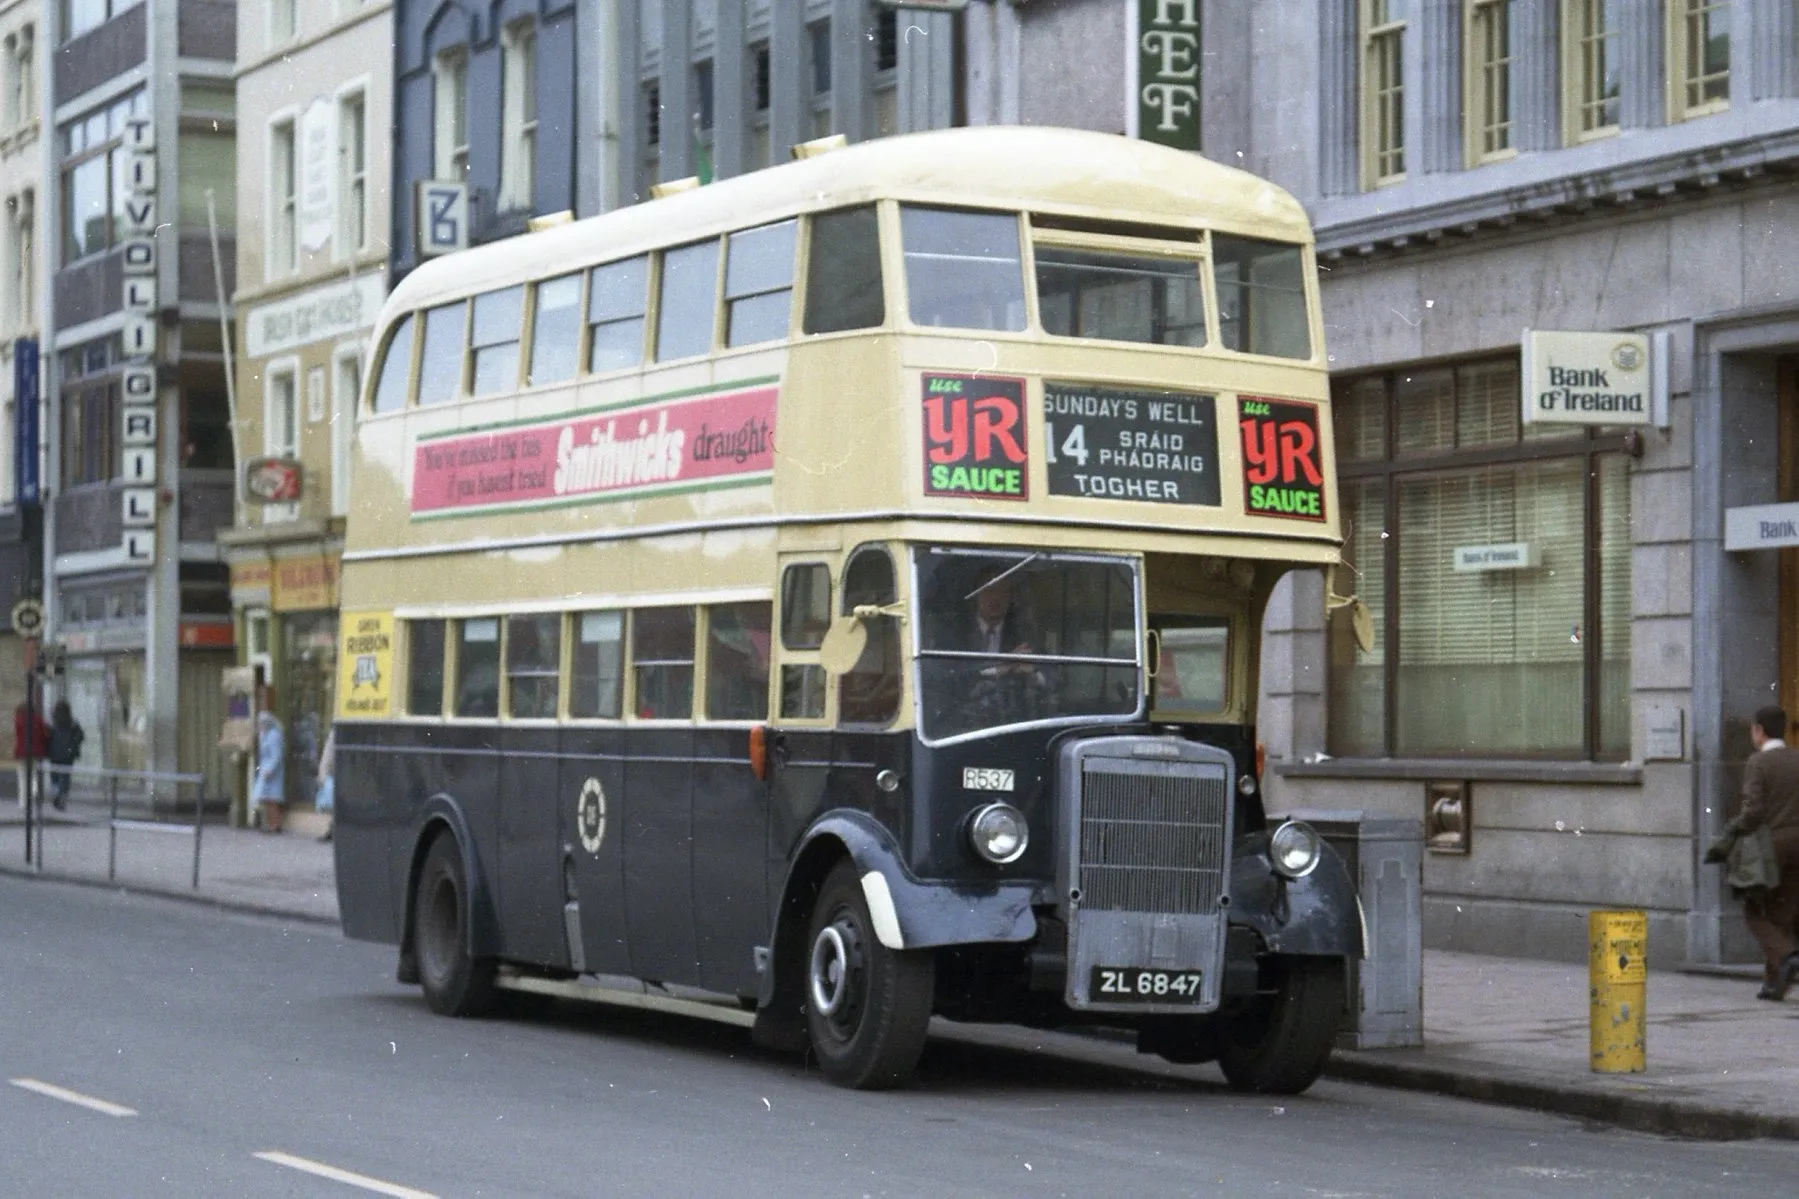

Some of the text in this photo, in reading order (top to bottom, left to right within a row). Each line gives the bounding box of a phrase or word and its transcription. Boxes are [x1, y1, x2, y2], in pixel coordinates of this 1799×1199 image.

[126, 120, 151, 558] TIVOLI GRILL
[929, 379, 963, 393] use
[1548, 366, 1609, 388] Bank
[1244, 401, 1271, 416] use
[1562, 387, 1643, 412] Ireland
[1149, 402, 1203, 425] WELL
[693, 418, 768, 463] draught
[1045, 421, 1089, 466] 14
[1119, 431, 1183, 451] SRÁID
[1100, 449, 1204, 472] PHÁDRAIG
[931, 464, 1021, 493] SAUCE
[1074, 475, 1180, 499] TOGHER
[1250, 485, 1320, 515] SAUCE
[1760, 519, 1797, 538] Bank
[965, 769, 1013, 789] R537
[1101, 971, 1201, 996] ZL 6847
